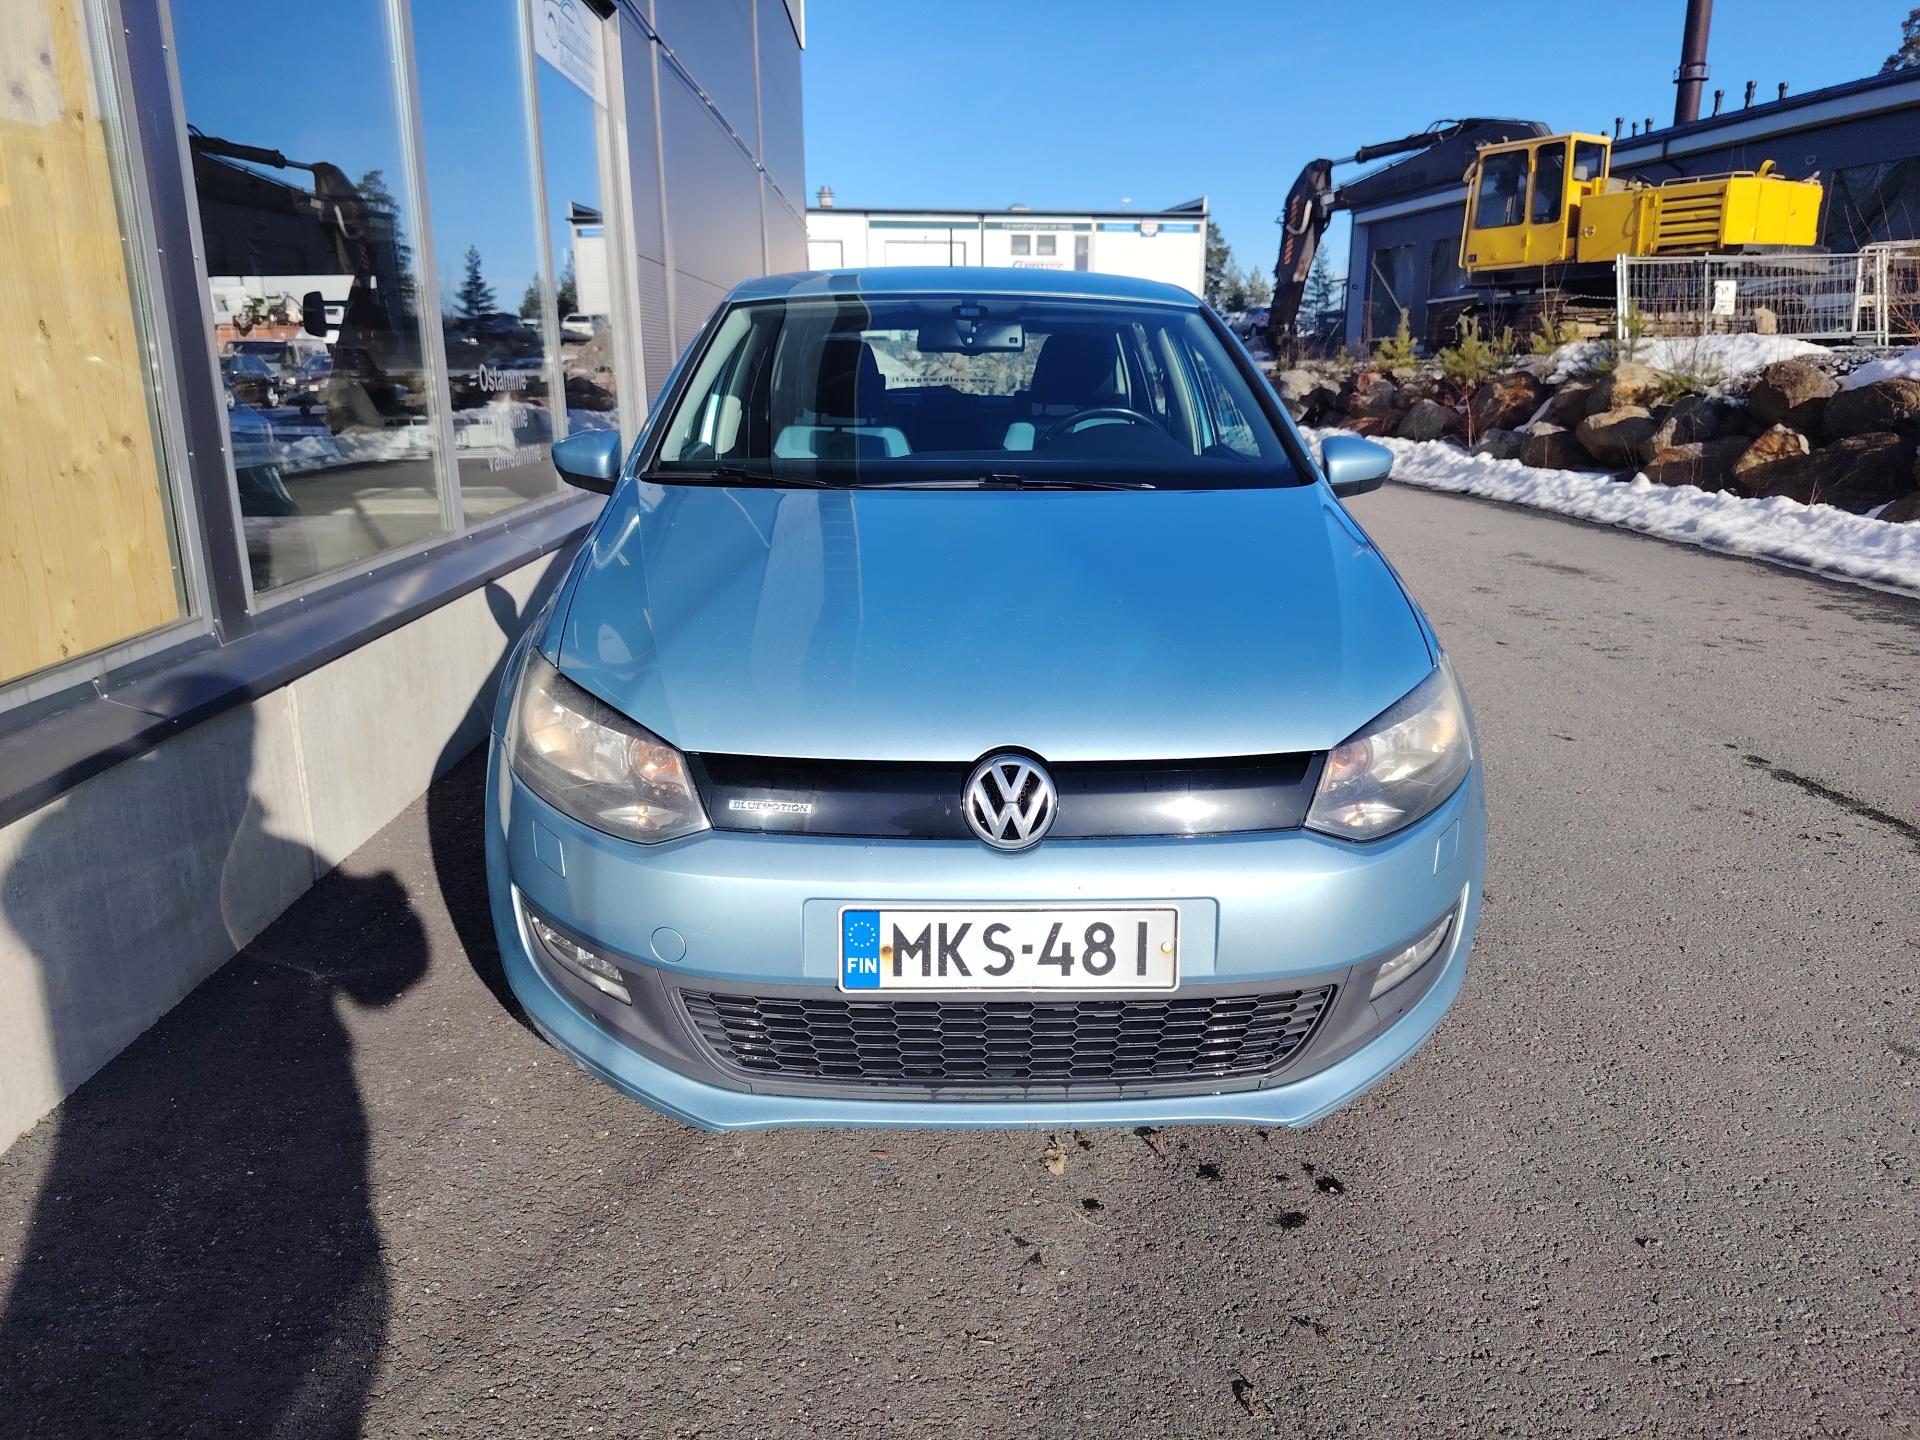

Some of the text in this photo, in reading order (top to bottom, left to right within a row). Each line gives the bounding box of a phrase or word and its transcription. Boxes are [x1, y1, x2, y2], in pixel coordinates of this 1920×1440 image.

[480, 364, 527, 392] Ostamme
[731, 800, 810, 813] BLUEMOTION
[892, 921, 1149, 977] MKS-481
[847, 957, 877, 974] FIN
